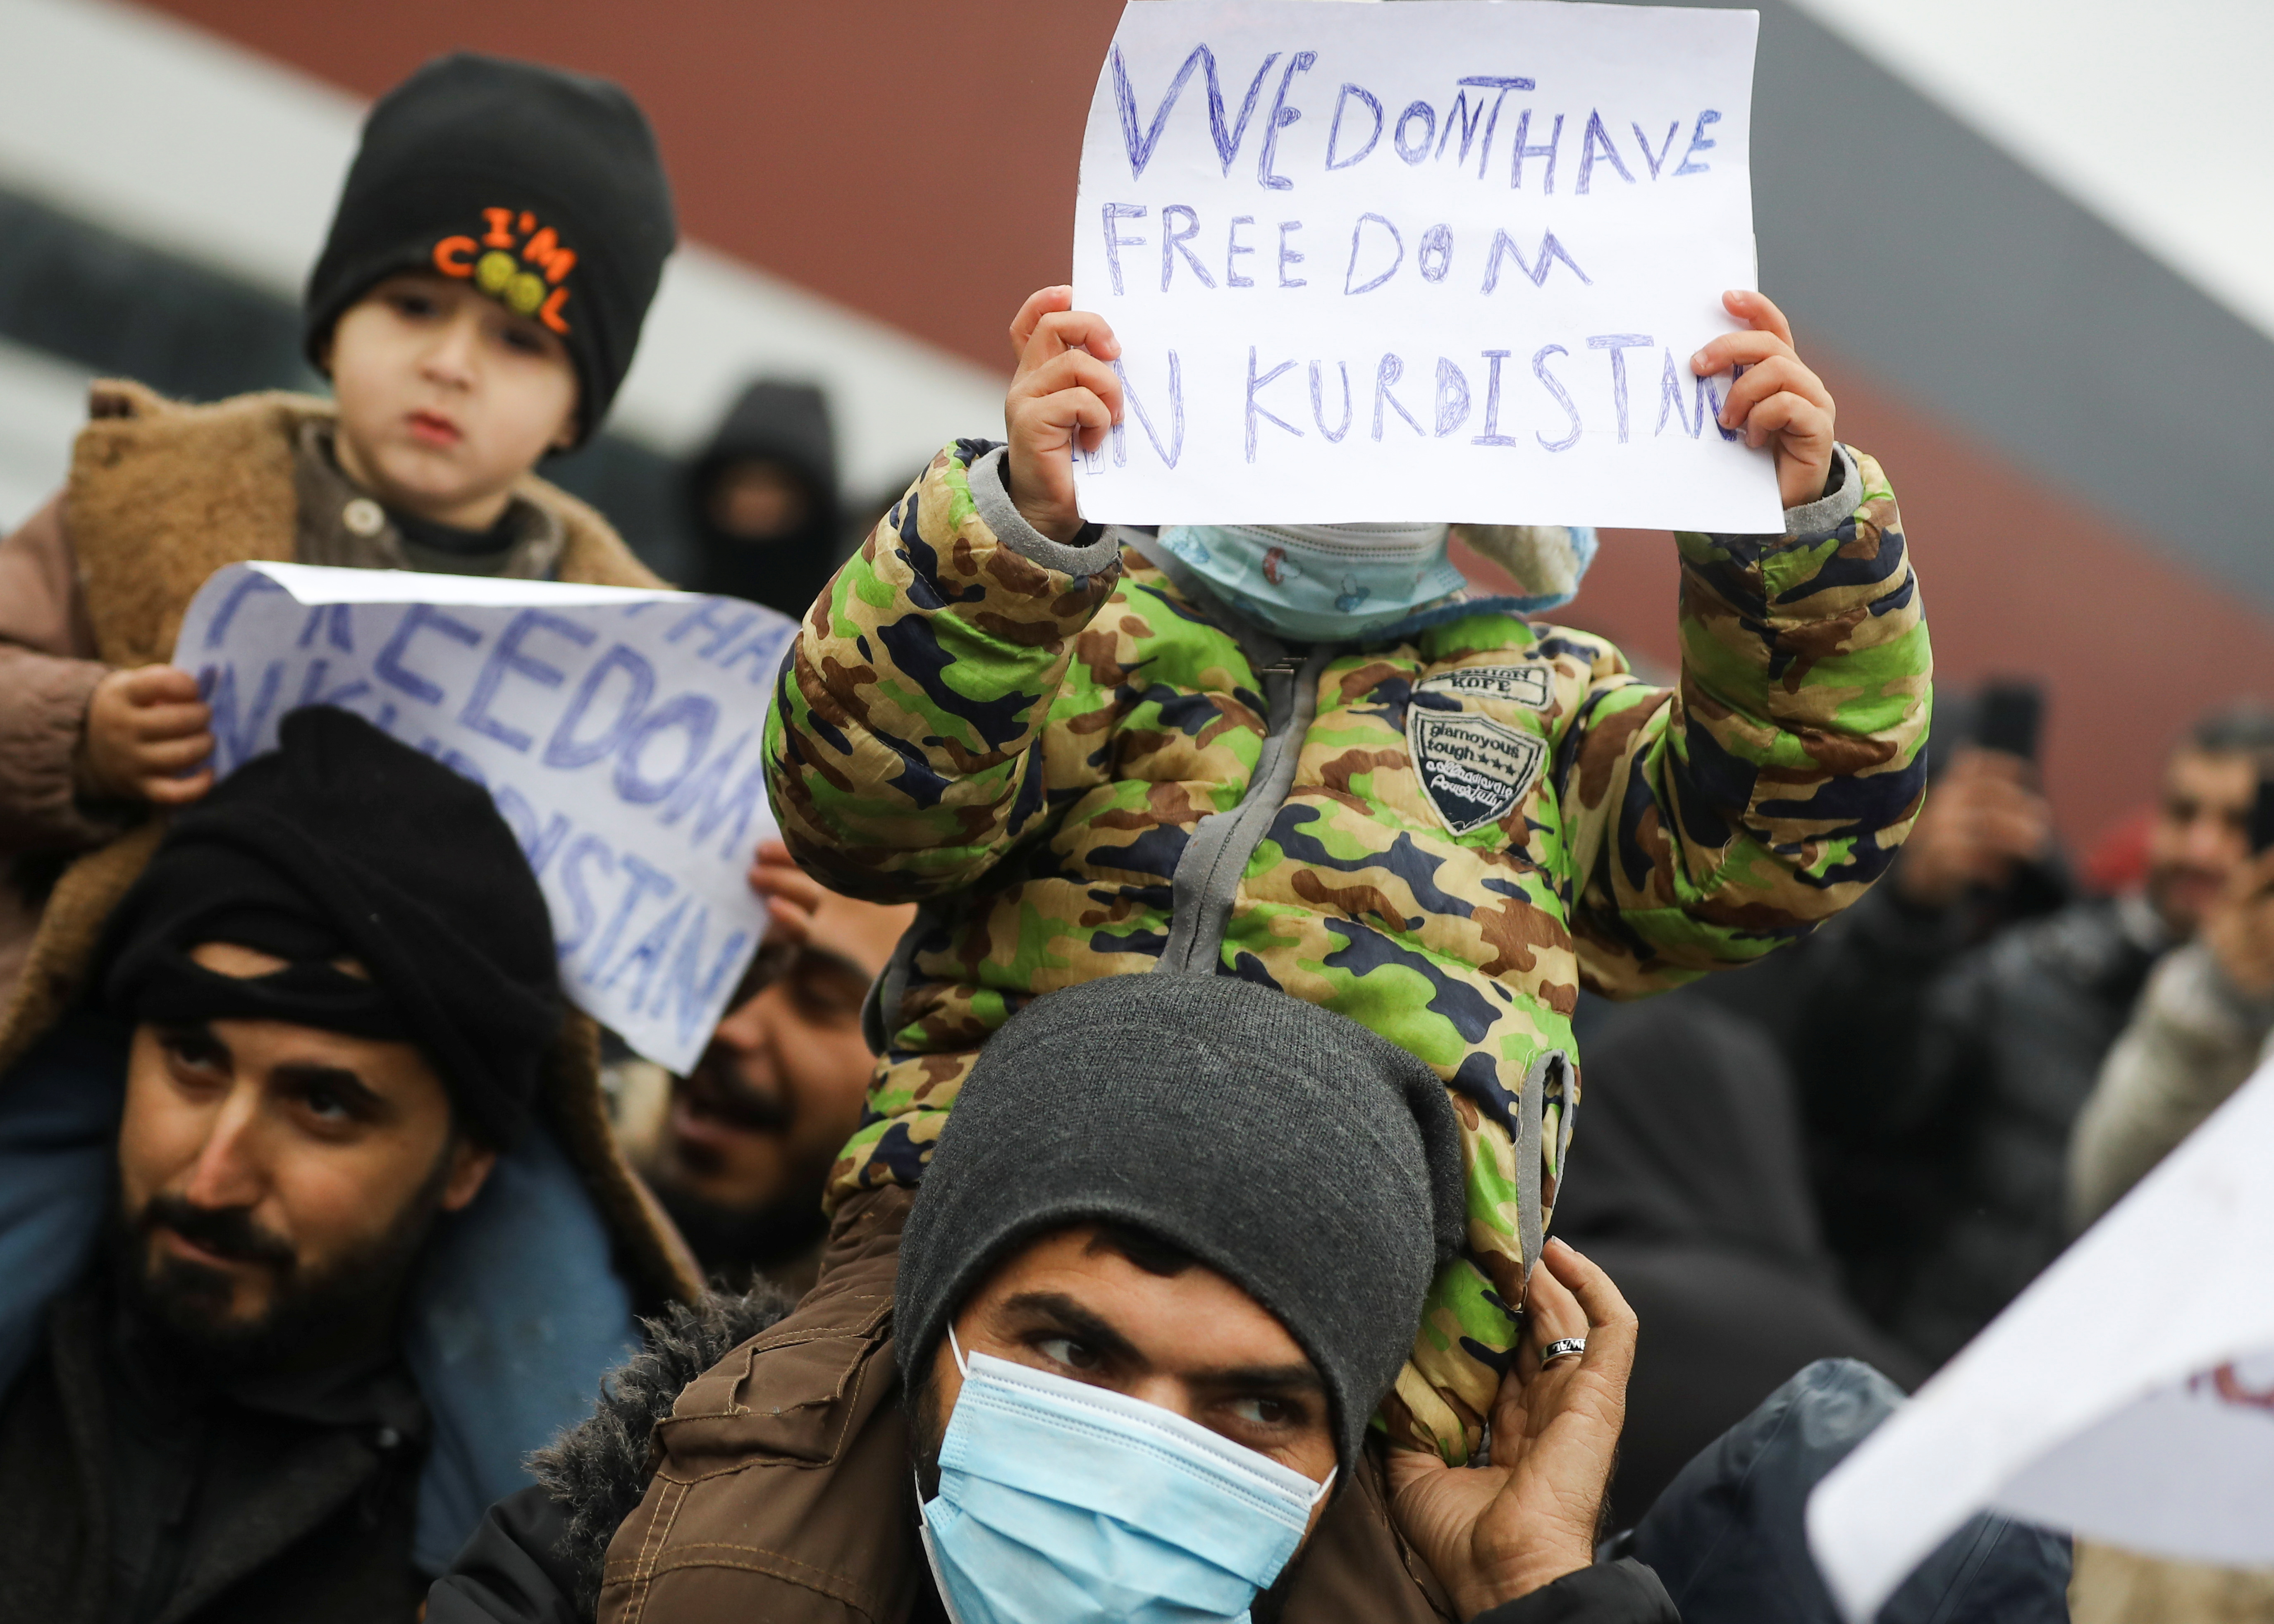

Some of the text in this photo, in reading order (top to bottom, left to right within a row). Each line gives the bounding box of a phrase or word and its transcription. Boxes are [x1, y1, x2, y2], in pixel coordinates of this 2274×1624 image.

[1110, 42, 1722, 197] WE DONT HAVE
[432, 234, 571, 336] COOL
[481, 206, 578, 285] I'M
[1103, 202, 1593, 296] FREEDOM
[1084, 349, 1185, 474] N
[666, 599, 792, 684] HA
[1427, 738, 1474, 761] tough
